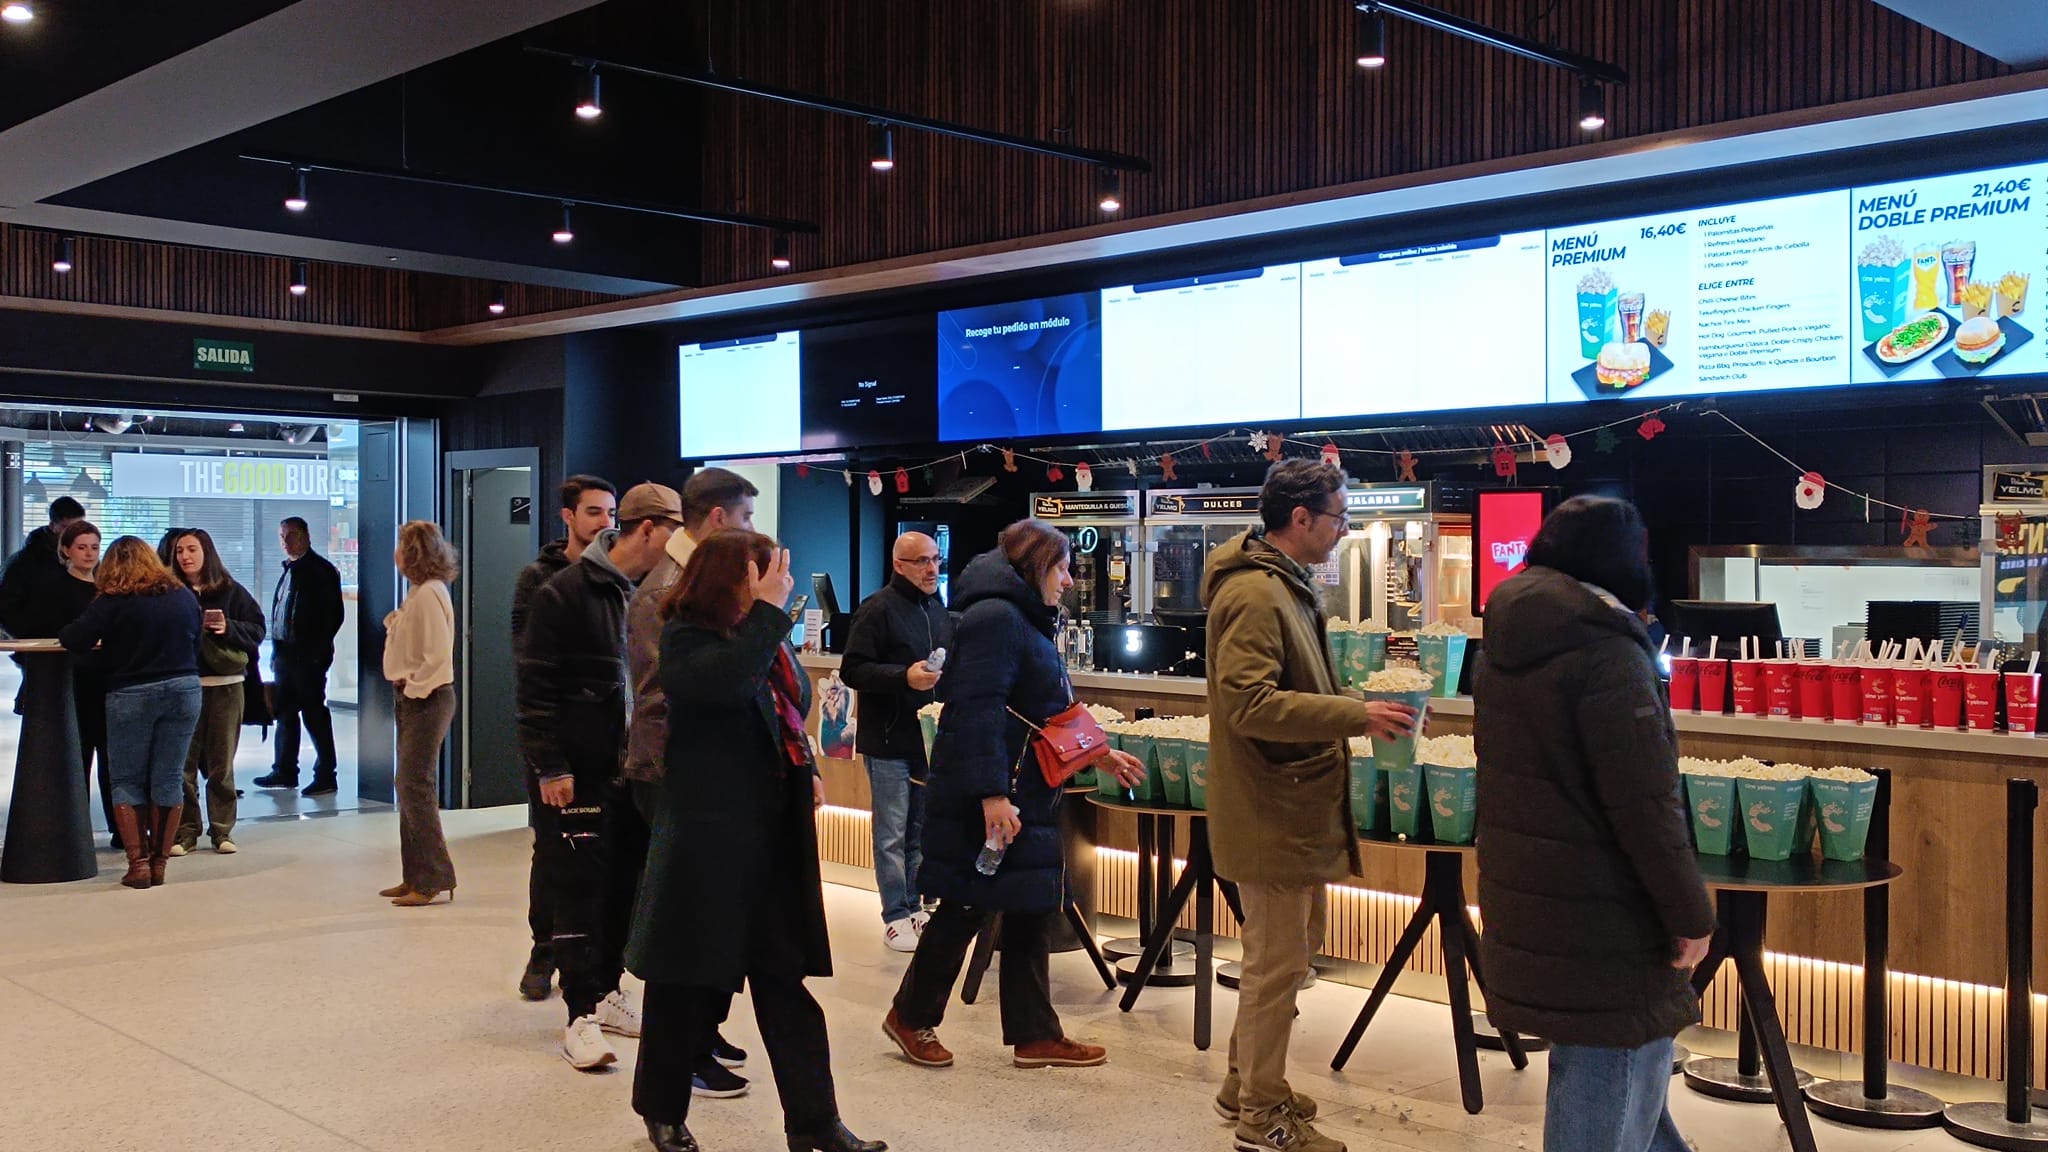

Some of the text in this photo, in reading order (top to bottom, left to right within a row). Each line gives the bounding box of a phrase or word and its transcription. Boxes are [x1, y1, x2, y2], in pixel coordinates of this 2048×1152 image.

[1972, 178, 2031, 198] 21,40€
[1858, 188, 1918, 214] MENÚ
[1698, 215, 1737, 227] INCLUYE
[1858, 196, 2031, 231] DOBLE PREMIUM
[1640, 222, 1686, 240] 16,40€
[1552, 230, 1598, 252] MENÚ
[1552, 246, 1626, 267] PREMIUM
[1698, 278, 1755, 290] ELIGE ENTRE
[966, 316, 1070, 338] Recoge tu pedido en módulo
[197, 347, 250, 364] SALIDA
[2000, 485, 2044, 495] YELMO
[1204, 500, 1242, 508] DULCES
